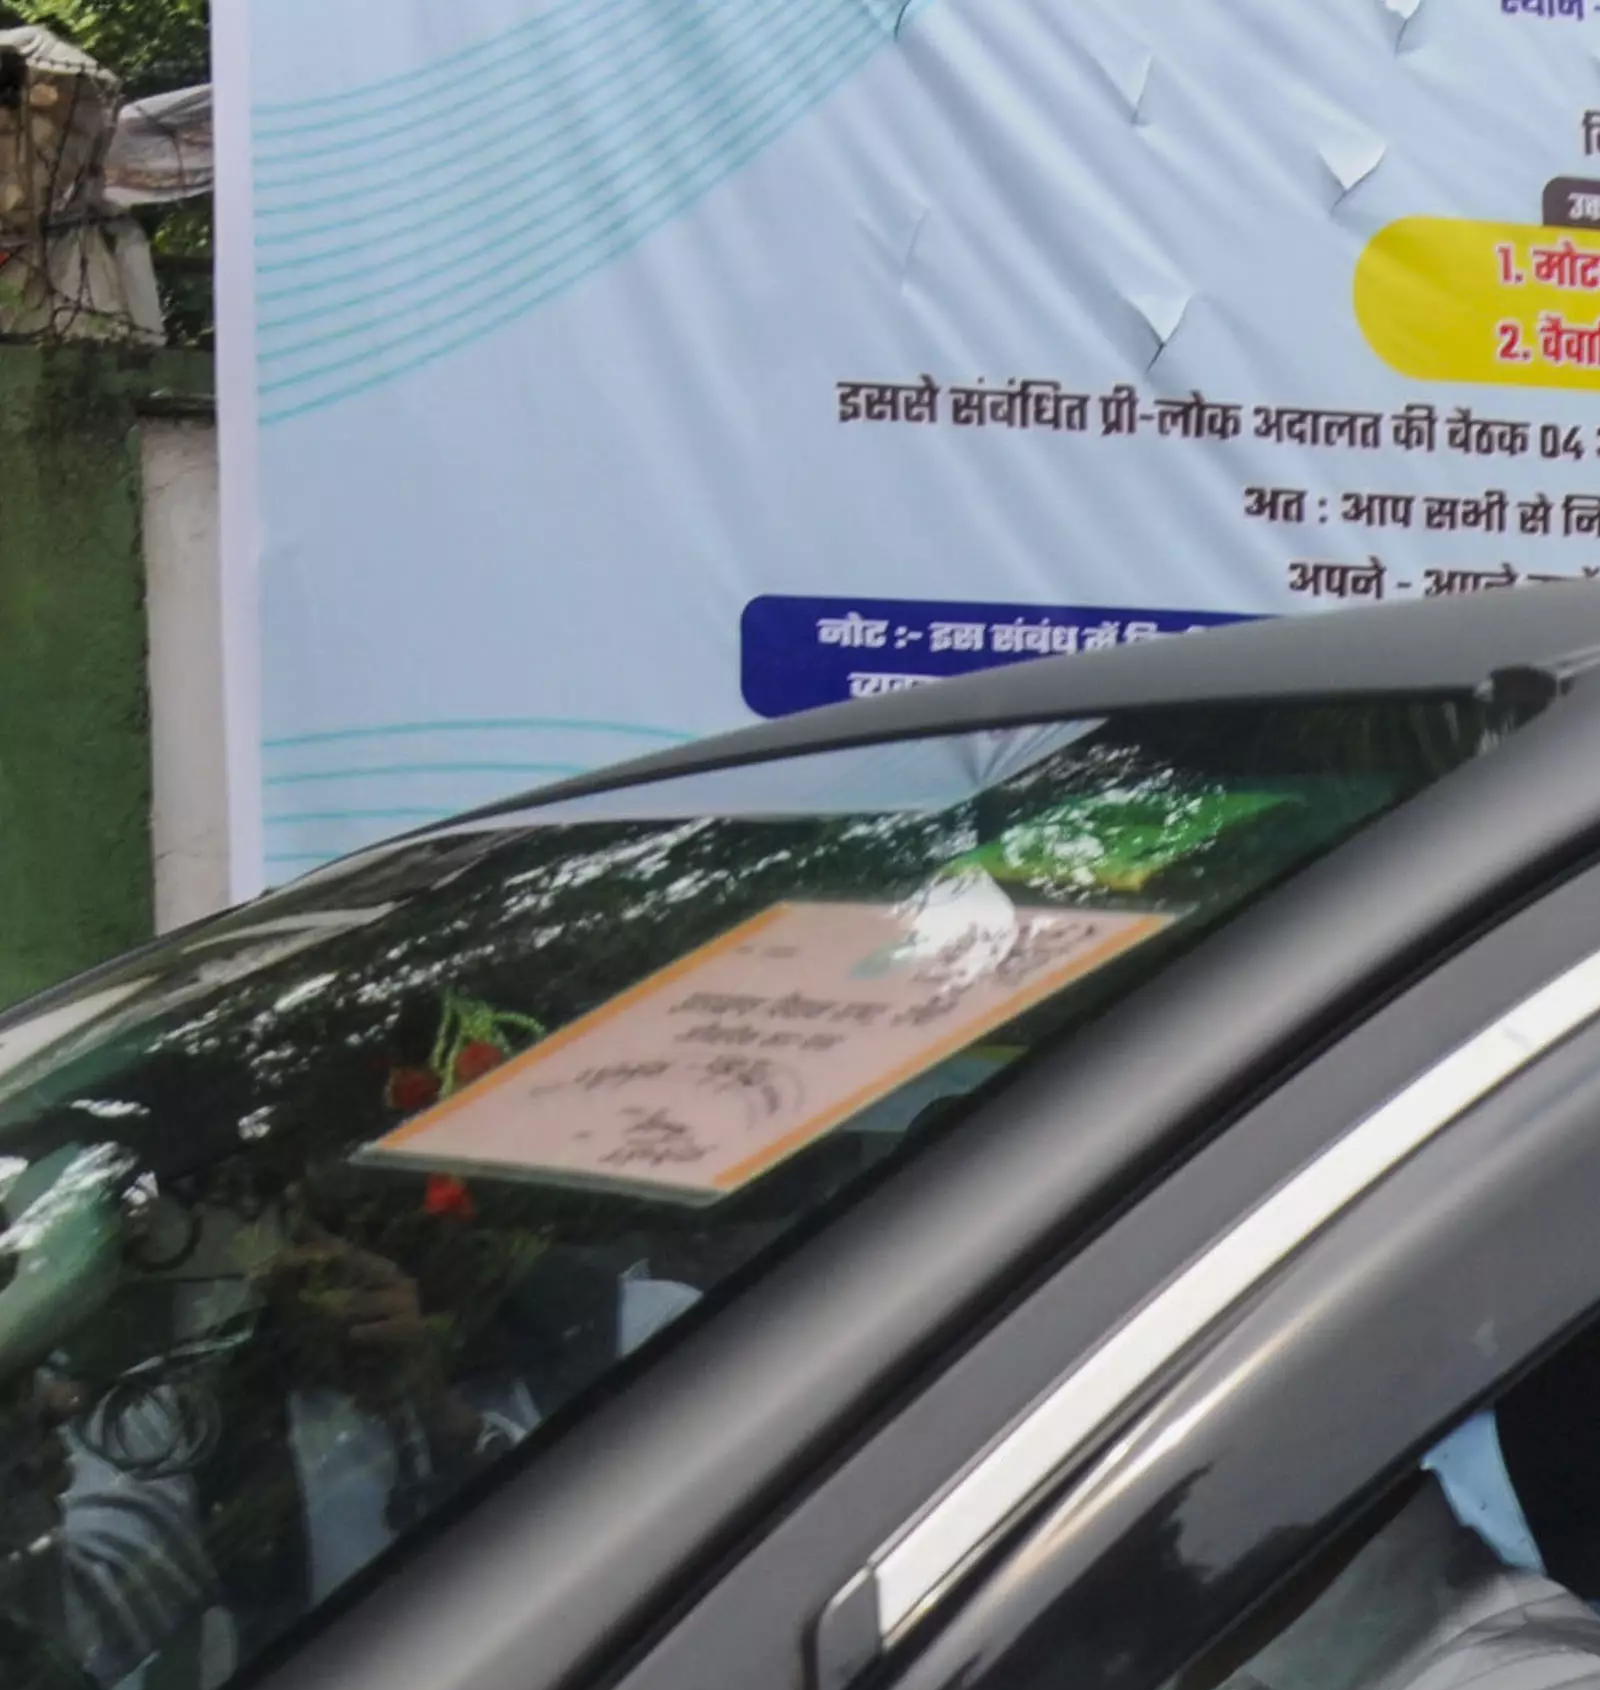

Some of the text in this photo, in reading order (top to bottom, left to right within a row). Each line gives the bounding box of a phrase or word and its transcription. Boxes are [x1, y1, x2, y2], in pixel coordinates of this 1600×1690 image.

[1500, 247, 1525, 286] 1.
[1499, 323, 1531, 363] 2.
[836, 374, 942, 424] इससे
[948, 377, 1090, 432] संबंधित
[1253, 405, 1383, 450] अदालत
[1391, 402, 1439, 453] की
[1445, 406, 1531, 458] बैठक
[1539, 423, 1586, 461] 04
[1244, 486, 1308, 525] अत
[1341, 491, 1417, 529] आप
[1423, 489, 1509, 534] सभी
[1517, 497, 1553, 537] से
[1288, 556, 1388, 601] अपने
[816, 611, 888, 648] नोट
[930, 621, 986, 653] इस
[990, 618, 1080, 656] संबंध
